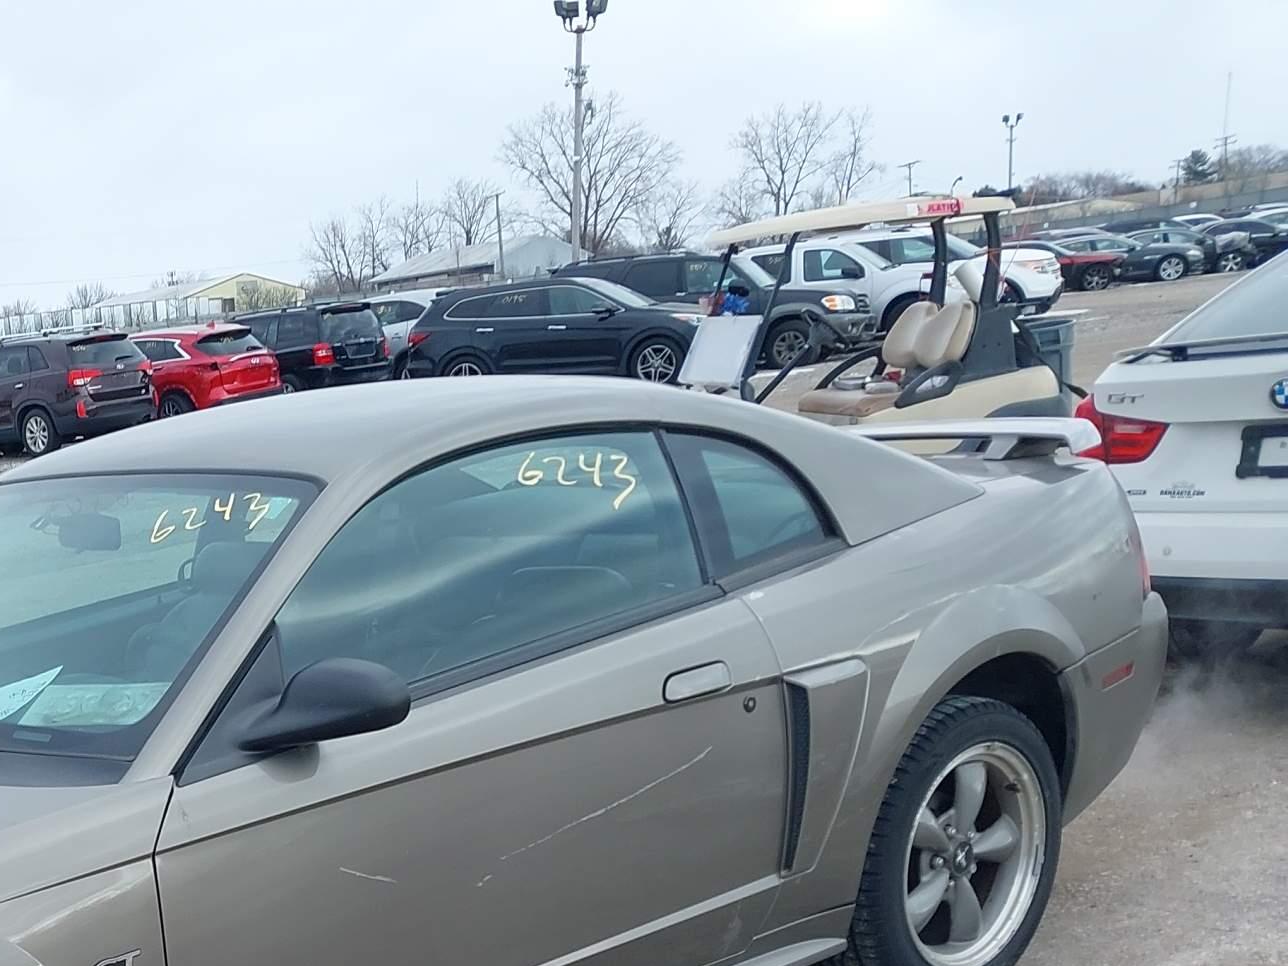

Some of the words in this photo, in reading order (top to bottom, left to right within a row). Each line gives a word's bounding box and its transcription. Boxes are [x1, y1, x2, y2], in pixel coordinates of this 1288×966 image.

[1107, 392, 1144, 404] GT
[518, 451, 636, 510] 6243
[150, 492, 269, 544] 6243
